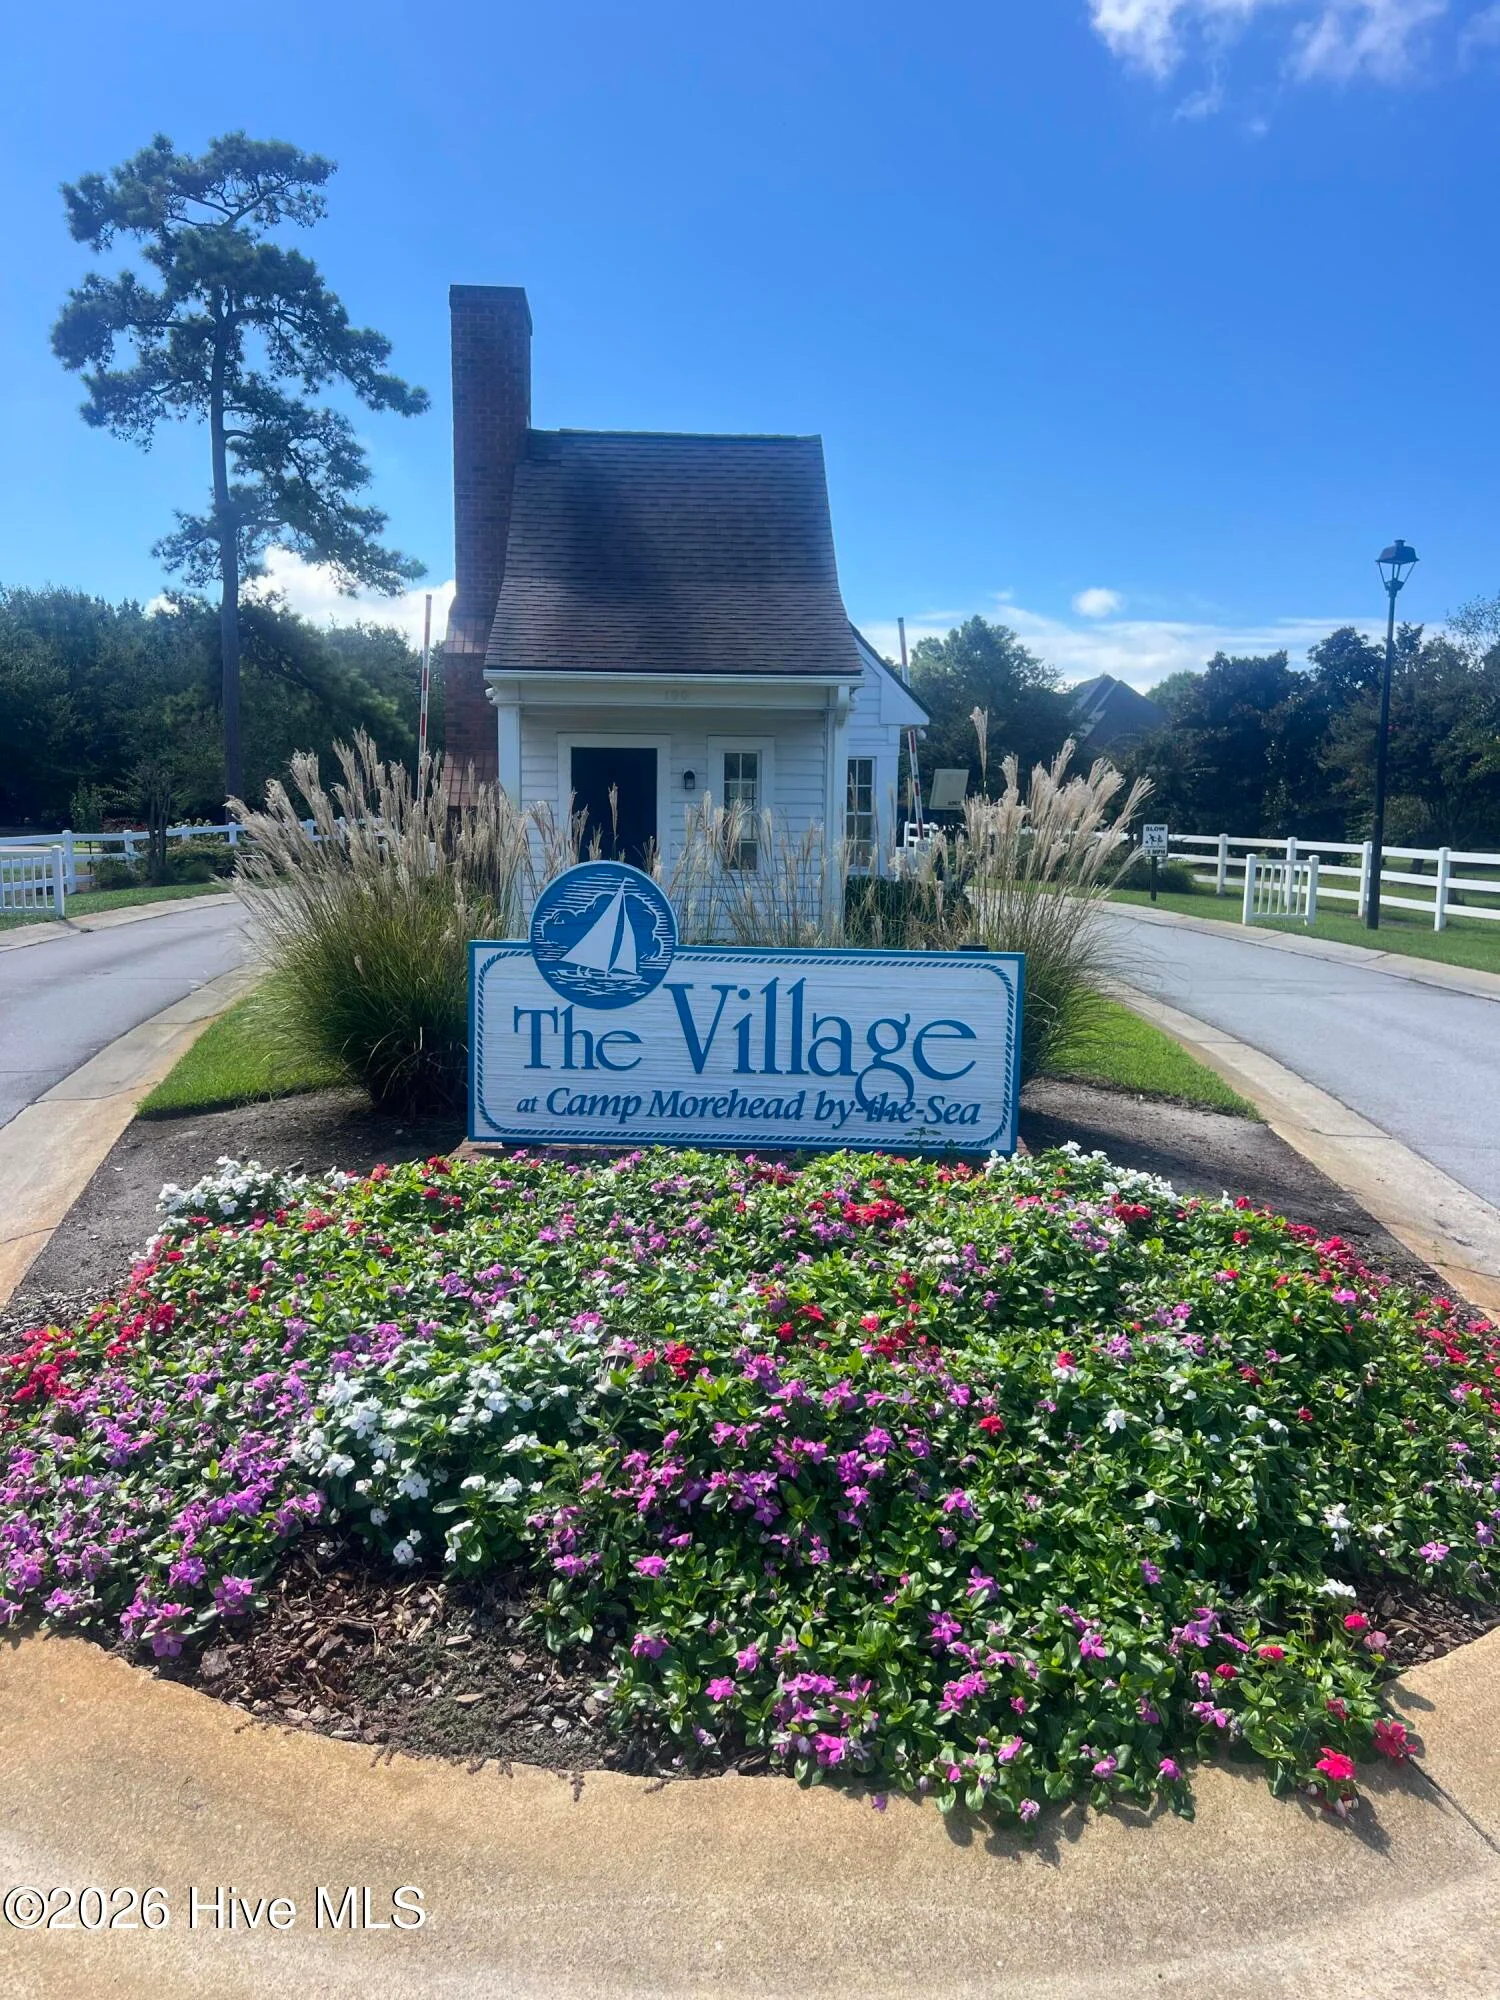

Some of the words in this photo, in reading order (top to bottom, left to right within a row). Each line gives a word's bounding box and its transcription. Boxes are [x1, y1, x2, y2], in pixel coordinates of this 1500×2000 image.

[513, 1004, 643, 1071] The
[662, 976, 978, 1113] Village
[516, 1095, 538, 1113] at
[545, 1087, 642, 1124] Camp
[646, 1088, 807, 1121] Morehead
[814, 1089, 982, 1130] by-the-Sea
